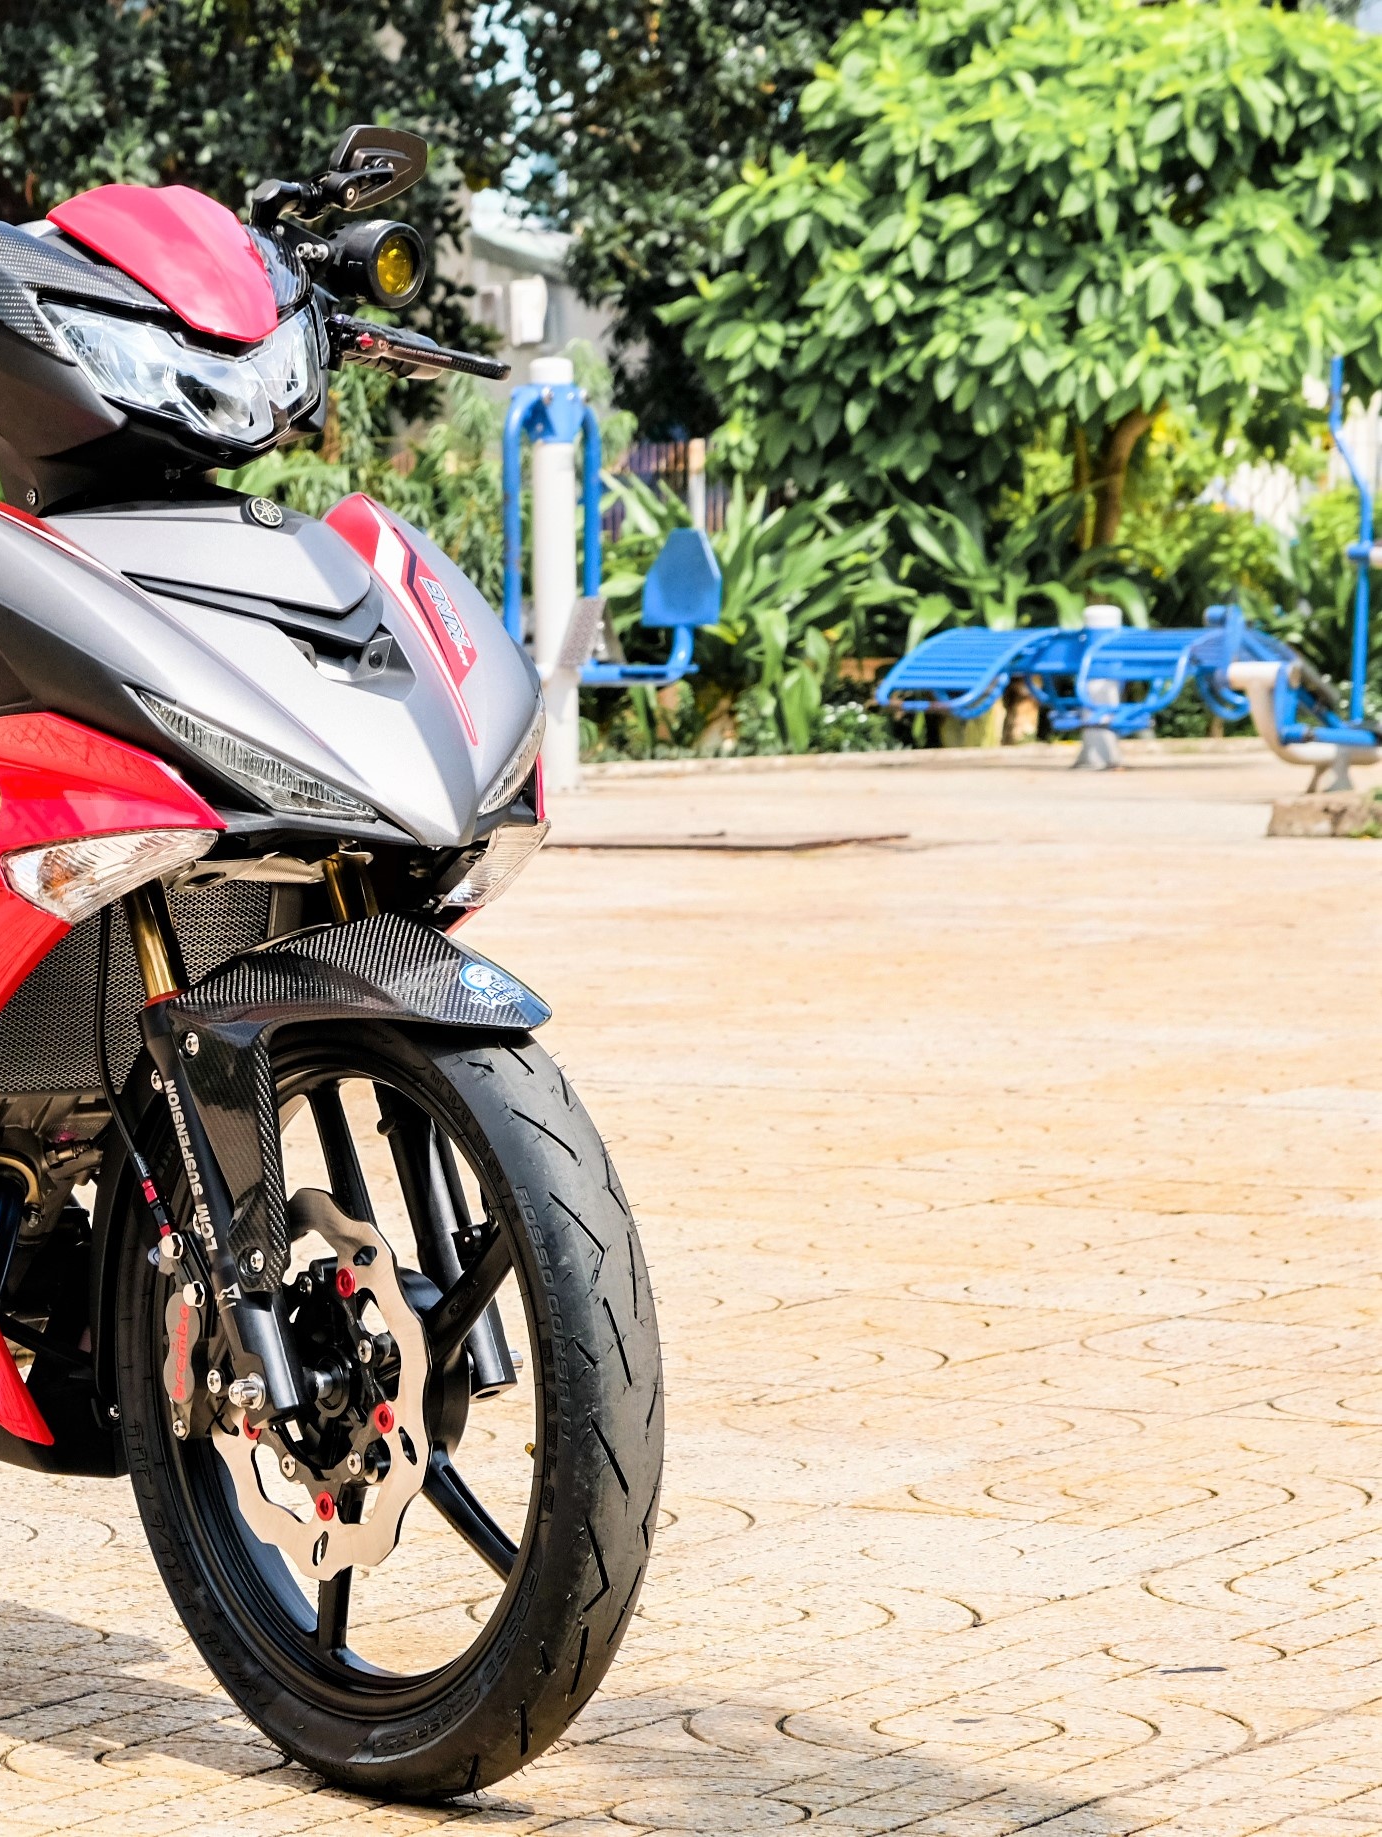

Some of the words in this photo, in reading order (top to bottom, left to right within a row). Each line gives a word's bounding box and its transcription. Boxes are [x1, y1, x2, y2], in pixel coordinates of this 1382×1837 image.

[419, 576, 472, 648] KING
[164, 1079, 204, 1197] SUSPENSION
[515, 1186, 555, 1288] ROSSO
[172, 1304, 190, 1399] brembo
